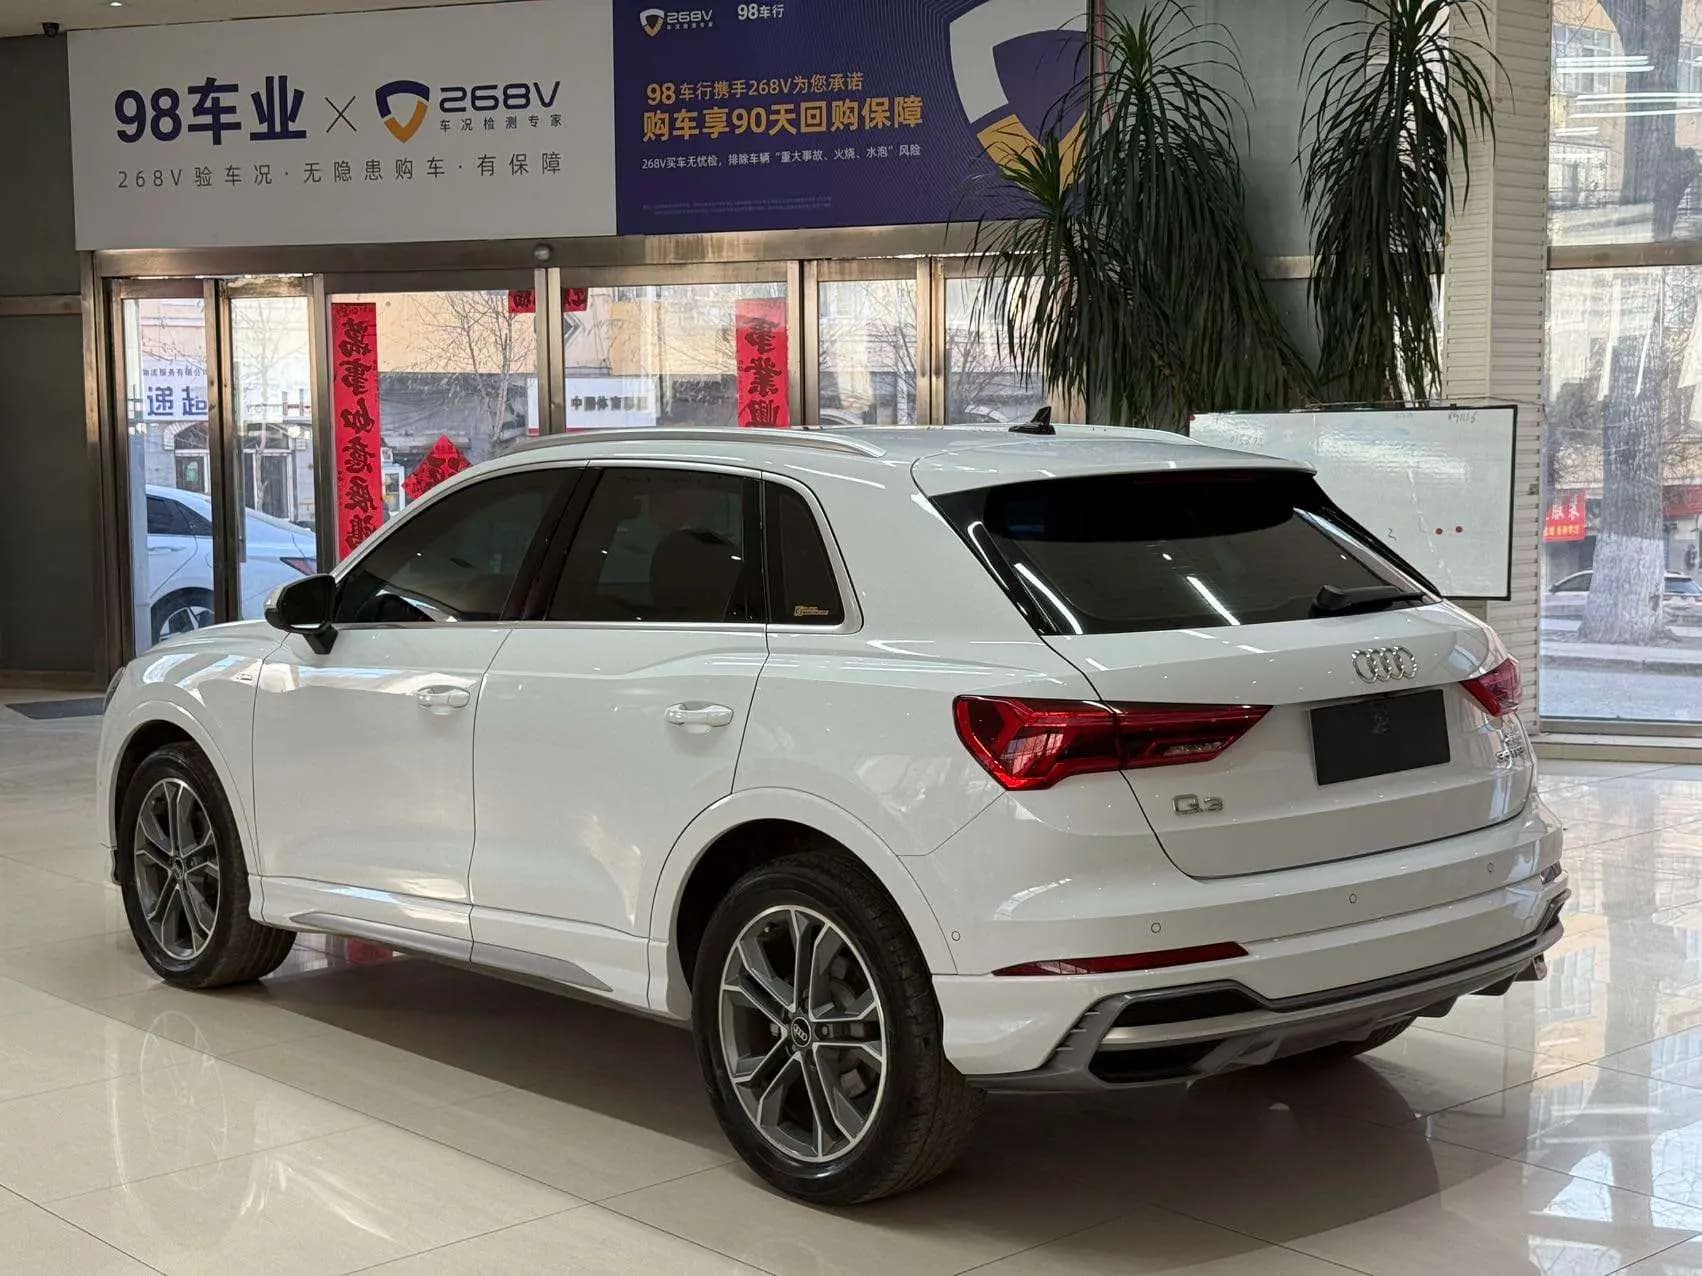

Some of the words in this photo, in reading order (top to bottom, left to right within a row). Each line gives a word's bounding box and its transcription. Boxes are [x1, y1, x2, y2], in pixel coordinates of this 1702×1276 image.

[667, 9, 713, 23] 268V
[738, 3, 784, 20] 98车行
[440, 81, 561, 113] 268V
[646, 71, 864, 105] 98车行携手268V为您承诺
[114, 75, 307, 146] 98车业
[440, 115, 562, 132] 车况检测专家
[642, 95, 924, 142] 购车享90天回购保障
[1173, 793, 1223, 816] Q3
